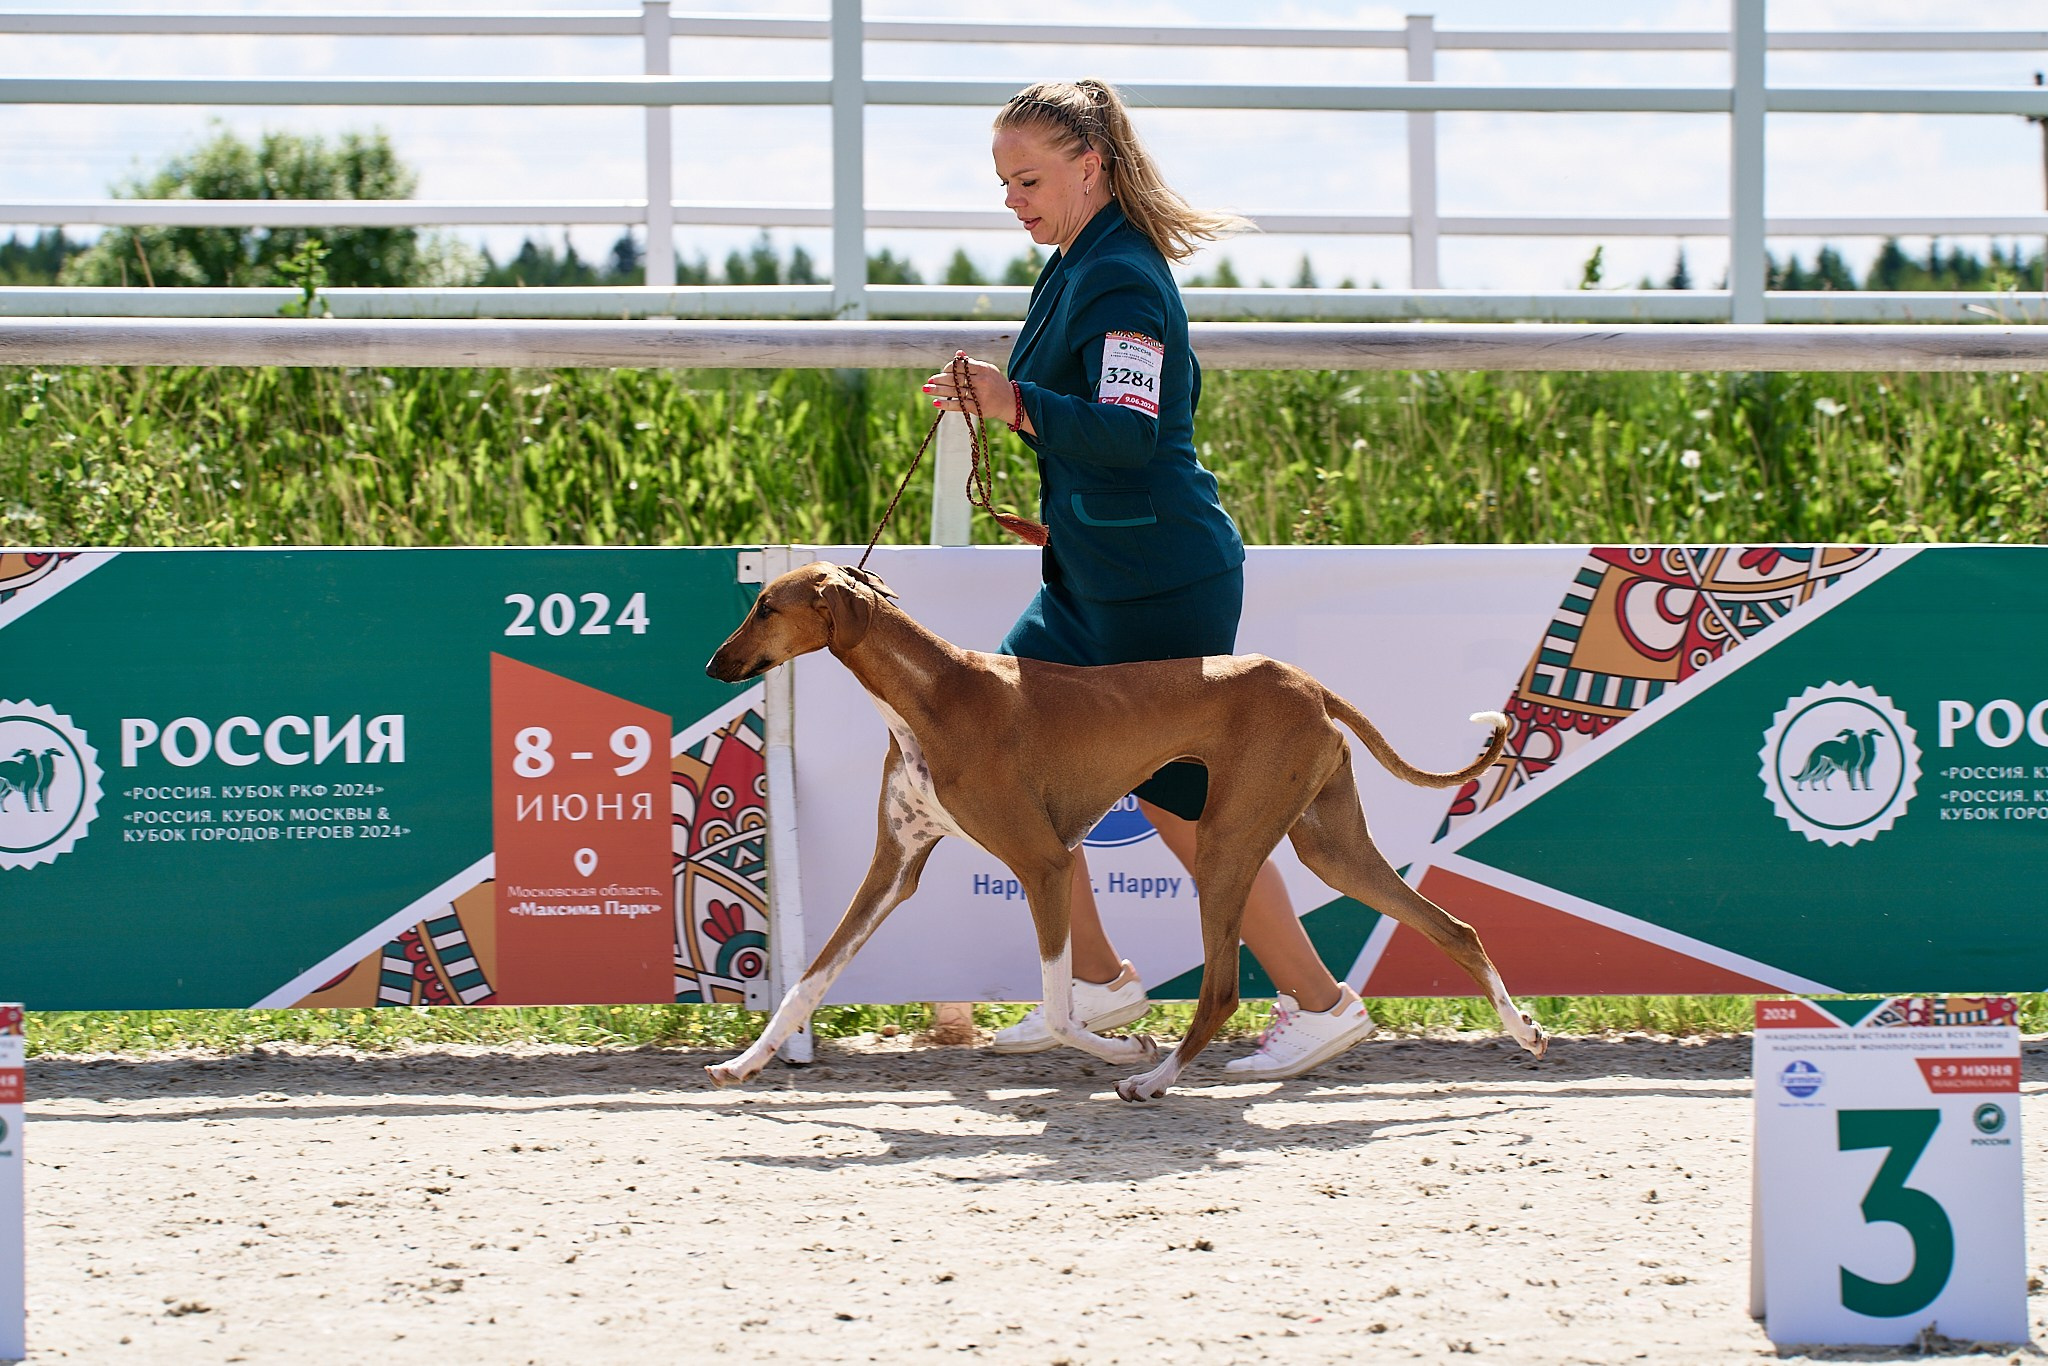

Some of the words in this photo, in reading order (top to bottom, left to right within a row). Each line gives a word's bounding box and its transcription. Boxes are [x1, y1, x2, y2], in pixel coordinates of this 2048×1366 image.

[1106, 367, 1154, 393] 3284
[1125, 396, 1155, 411] 9.06.2024
[504, 592, 650, 636] 2024
[121, 714, 405, 767] РОССИЯ
[512, 726, 555, 778] 8
[609, 725, 652, 777] 9
[1940, 766, 2029, 779] «РОССИЯ.
[123, 786, 217, 800] «РОССИЯ.
[222, 785, 284, 799] КУБОК
[289, 784, 328, 798] РКФ
[332, 783, 384, 797] 2024»
[1940, 789, 2029, 802] «РОССИЯ.
[123, 810, 217, 824] «РОССИЯ.
[222, 809, 284, 822] КУБОК
[289, 807, 372, 821] МОСКВЫ
[377, 807, 391, 820] &
[516, 793, 652, 821] ИЮНЯ
[1940, 807, 2000, 820] КУБОК
[123, 828, 186, 842] КУБОК
[191, 826, 354, 842] ГОРОДОВ-ГЕРОЕВ
[359, 825, 411, 838] 2024»
[507, 886, 597, 897] Московская
[1109, 872, 1181, 898] Happy
[508, 902, 602, 916] «Максима
[604, 901, 662, 919] Парк»
[1762, 1007, 1797, 1021] 2024
[1931, 1064, 1957, 1077] 8-9
[1961, 1064, 2013, 1077] ИЮНЯ
[1971, 1138, 2011, 1146] РОССИЯ
[1836, 1109, 1955, 1318] 3
